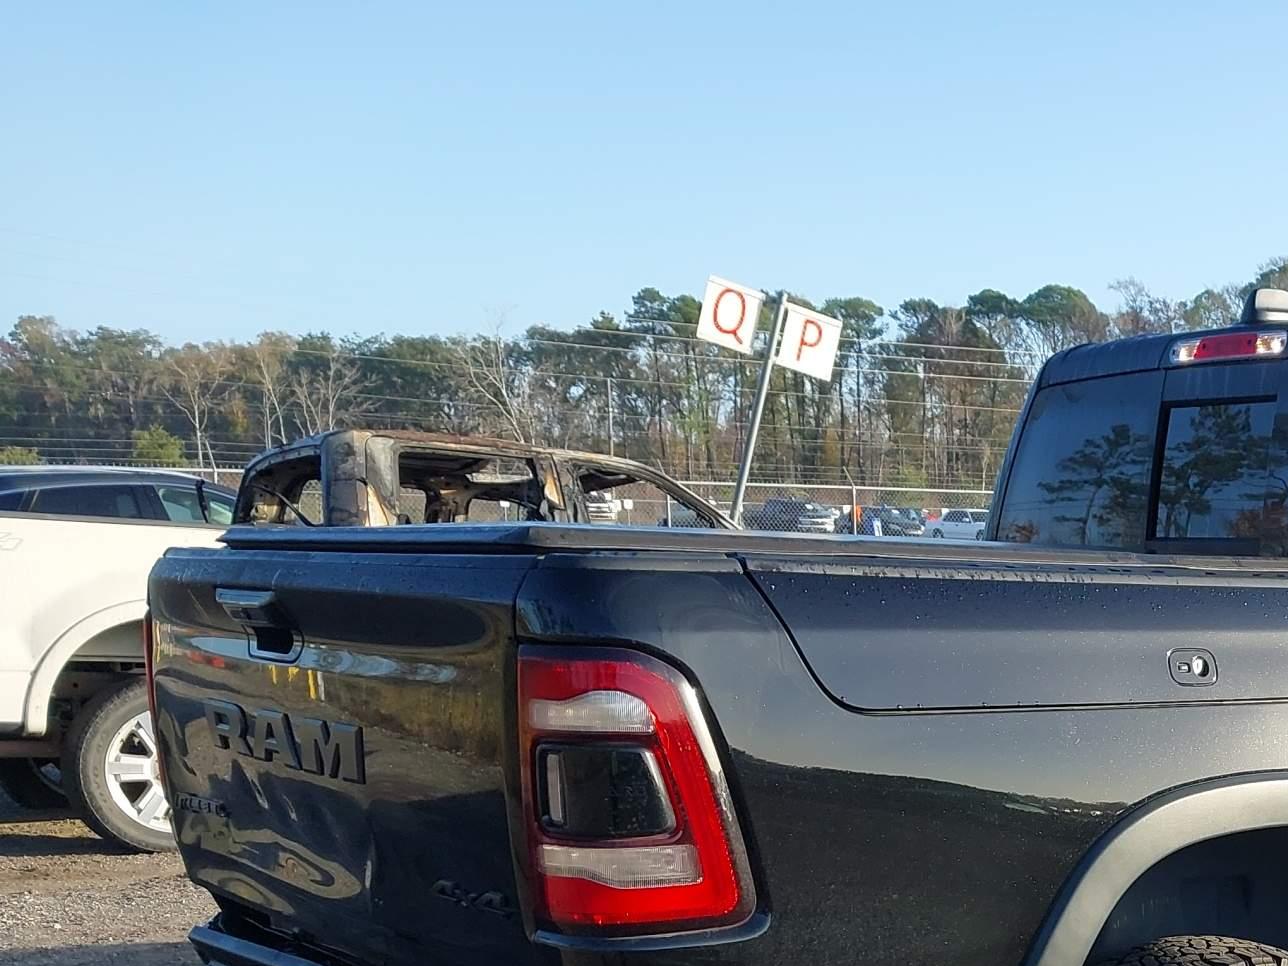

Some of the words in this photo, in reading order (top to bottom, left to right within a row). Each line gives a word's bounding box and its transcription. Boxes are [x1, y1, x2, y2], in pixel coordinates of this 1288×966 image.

[712, 287, 746, 345] Q
[796, 318, 823, 361] P
[204, 697, 367, 785] RAM
